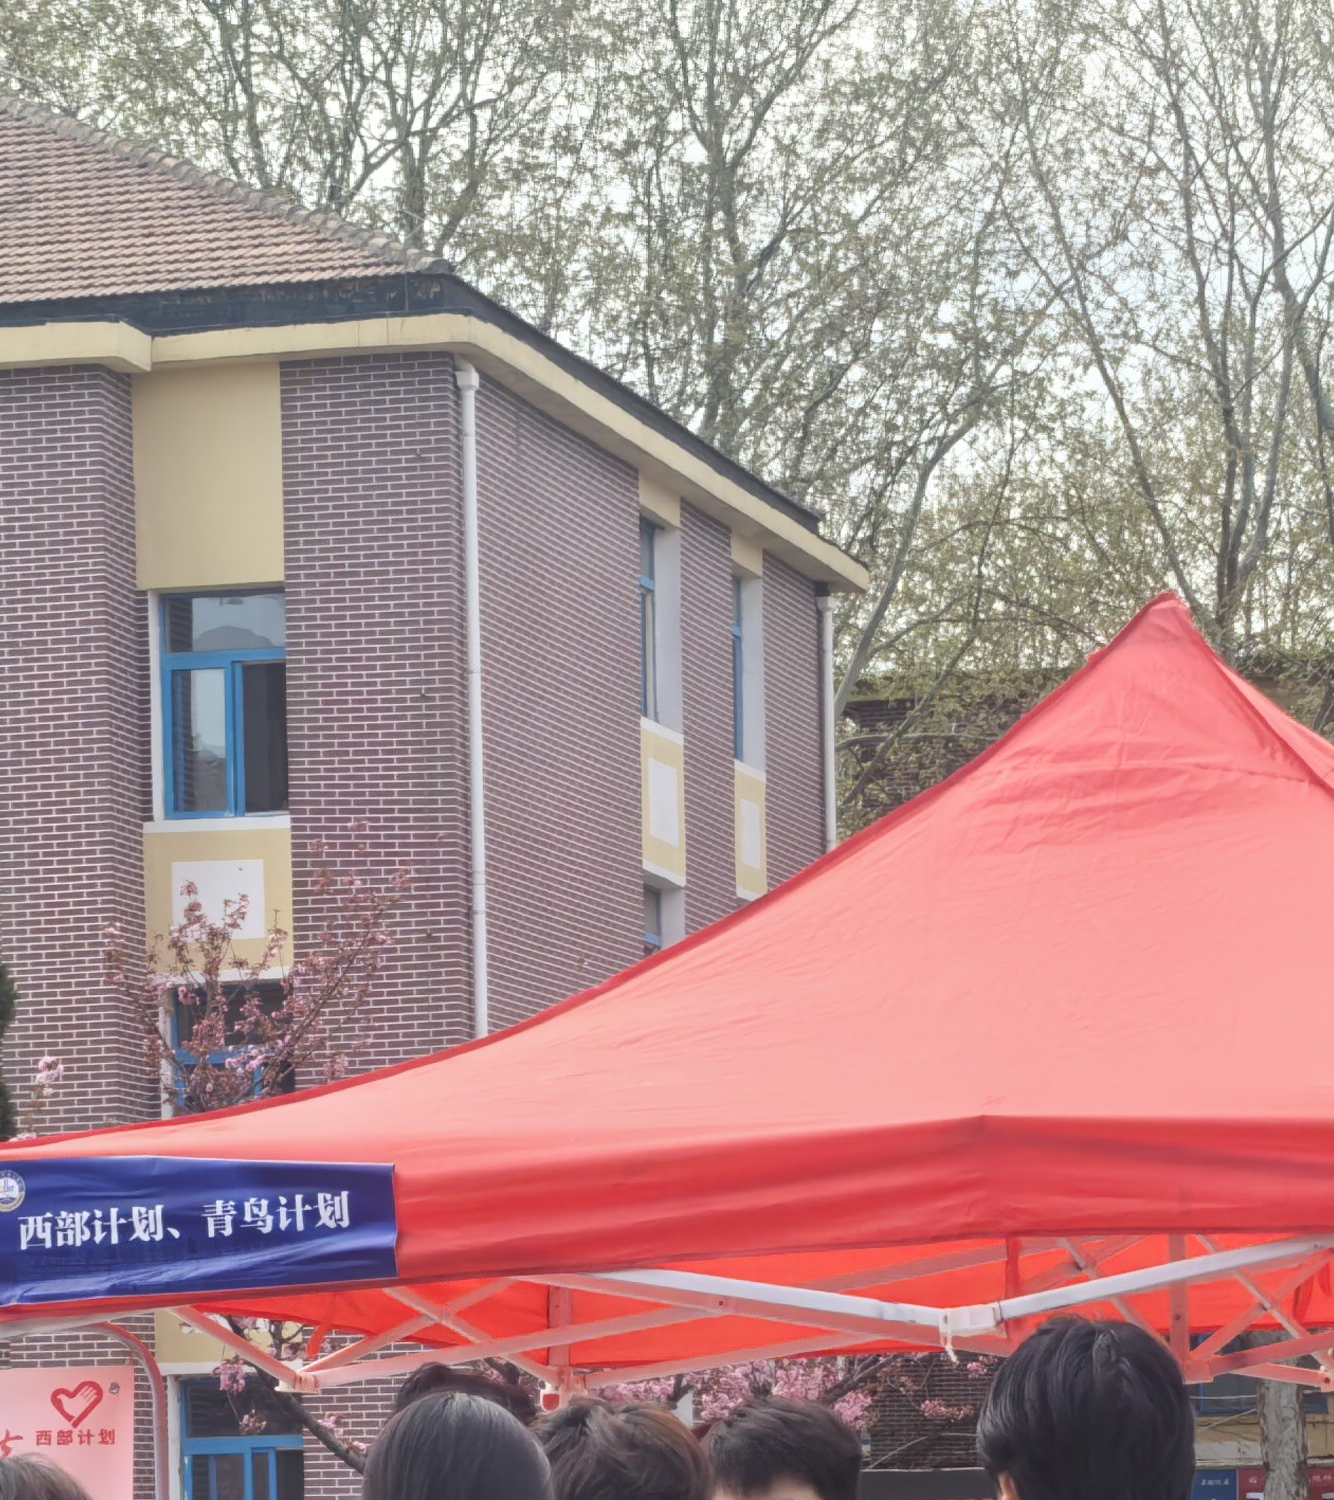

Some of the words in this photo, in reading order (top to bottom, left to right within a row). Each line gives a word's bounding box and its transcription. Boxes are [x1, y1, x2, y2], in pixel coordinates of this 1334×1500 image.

[18, 1191, 350, 1249] 西部计划、青鸟计划
[35, 1428, 116, 1447] 西部计划
